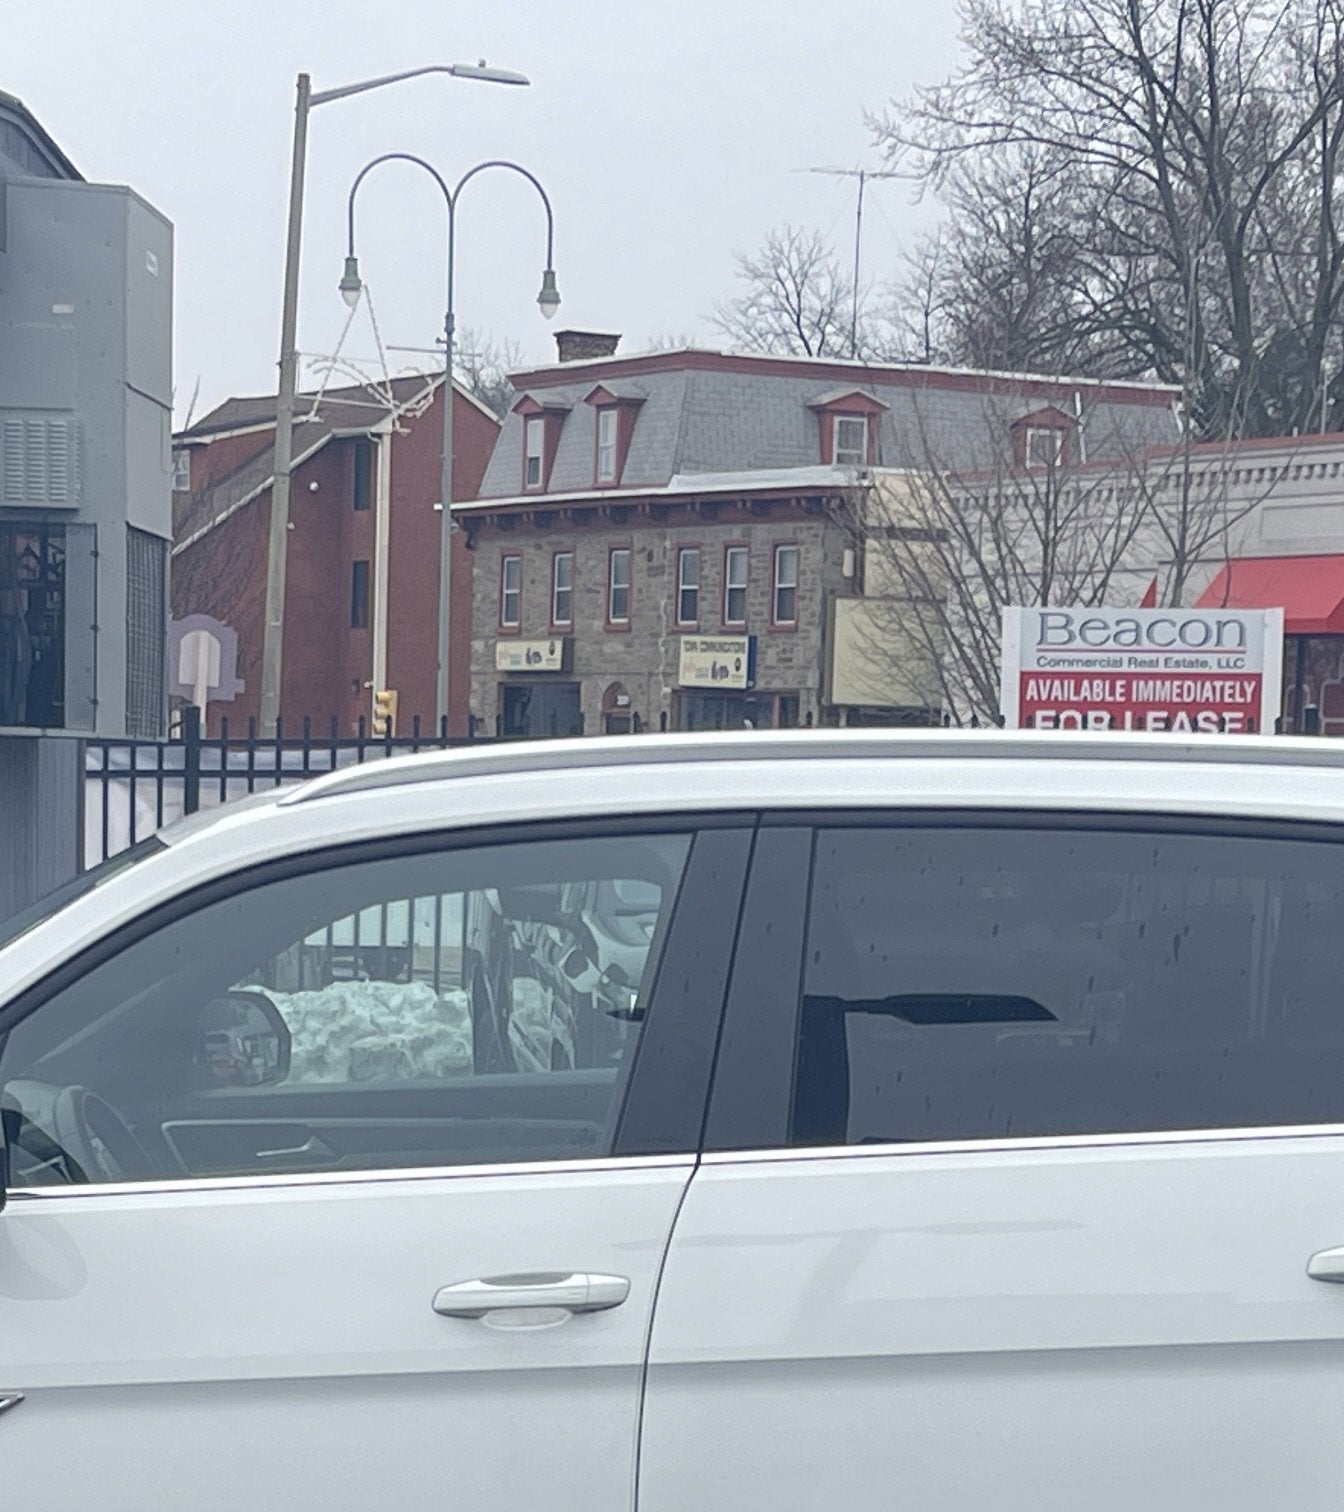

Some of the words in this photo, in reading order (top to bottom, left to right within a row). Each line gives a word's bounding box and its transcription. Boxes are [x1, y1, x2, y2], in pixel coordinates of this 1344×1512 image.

[1036, 611, 1247, 648] Beacon
[1036, 655, 1123, 669] Commercial
[1127, 656, 1160, 669] Real
[1164, 656, 1213, 671] Estate,
[1217, 657, 1246, 670] LLC
[1025, 678, 1127, 703] AVAILABLE
[1131, 679, 1257, 705] IMMEDIATELY
